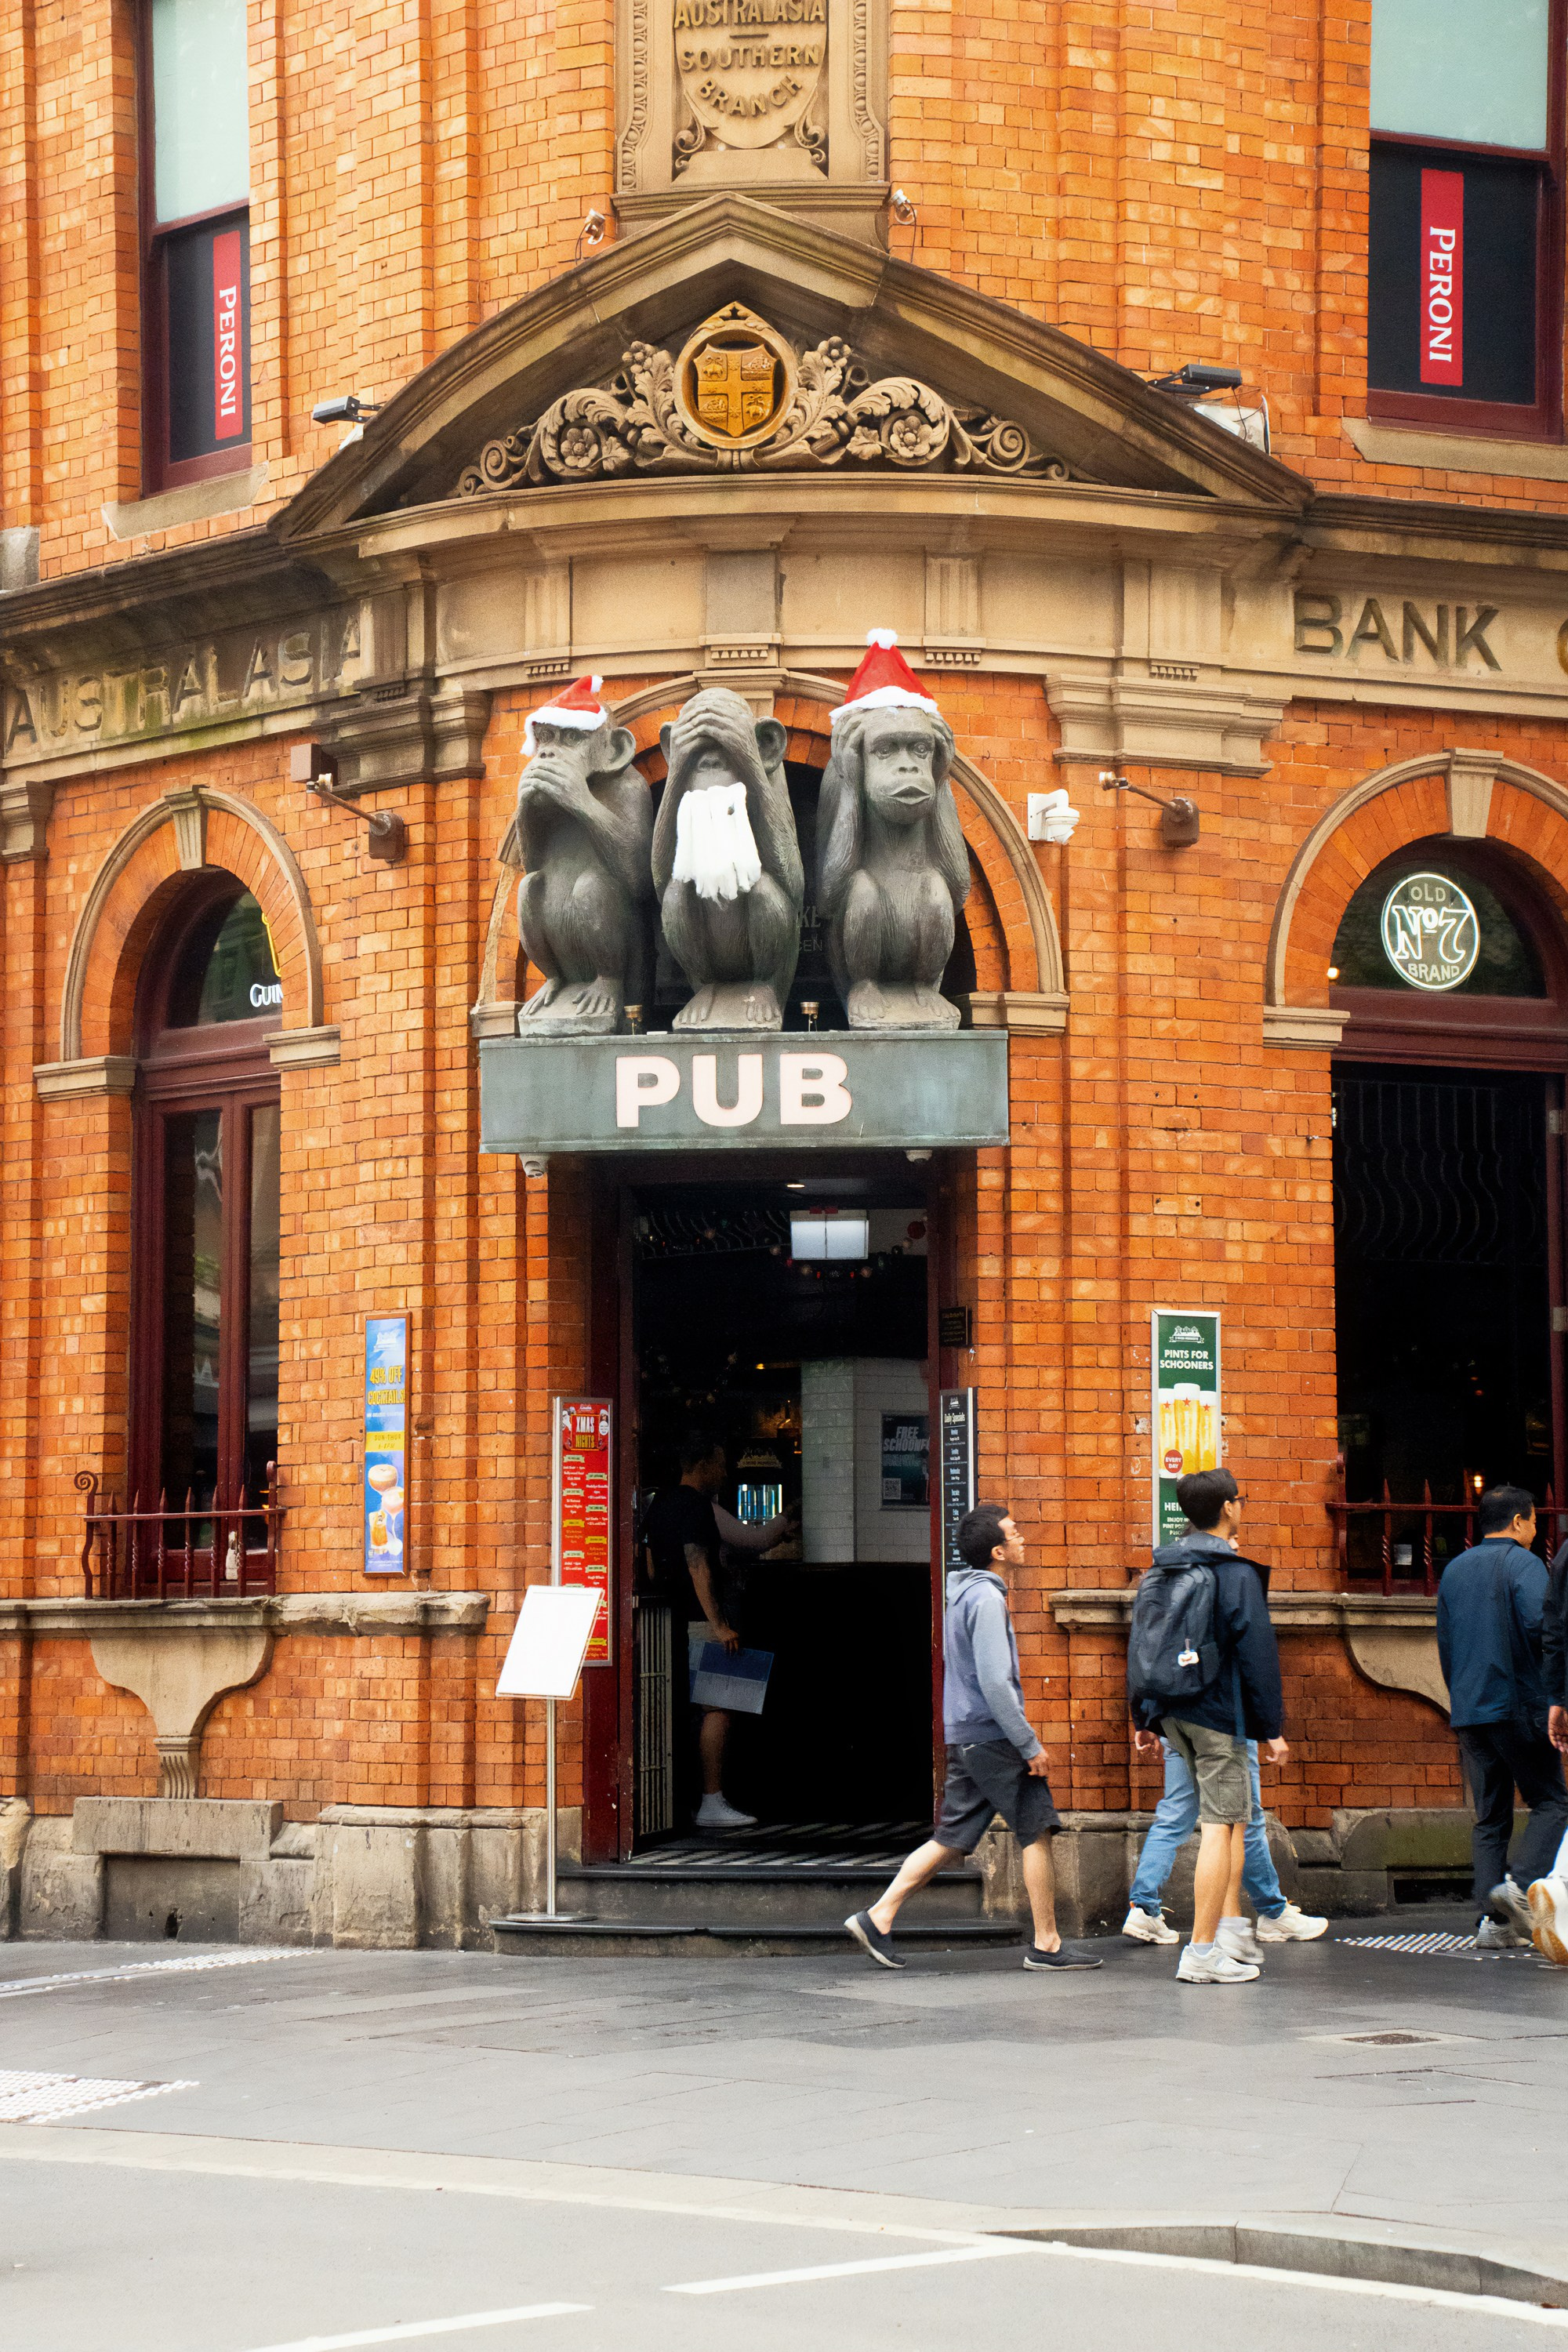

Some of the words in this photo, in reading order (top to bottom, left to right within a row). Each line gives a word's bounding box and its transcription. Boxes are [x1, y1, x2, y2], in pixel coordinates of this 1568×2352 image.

[673, 0, 826, 29] AUSTRALASIA
[680, 43, 821, 71] SOUTHERN
[698, 73, 803, 117] BRANCH
[1428, 226, 1456, 362] PERONI
[219, 285, 237, 417] PERONI
[1294, 592, 1502, 672] BANK
[3, 599, 376, 759] AUSTRALASIA
[1410, 883, 1446, 902] OLD
[1407, 963, 1460, 982] BRAND
[615, 1053, 853, 1127] PUB
[1160, 1359, 1214, 1370] SCHOONERS
[1164, 1349, 1189, 1359] PINTS
[1191, 1350, 1209, 1359] FOR
[388, 1365, 403, 1385] OFF
[576, 1416, 595, 1433] XMAS
[895, 1426, 919, 1439] FREE
